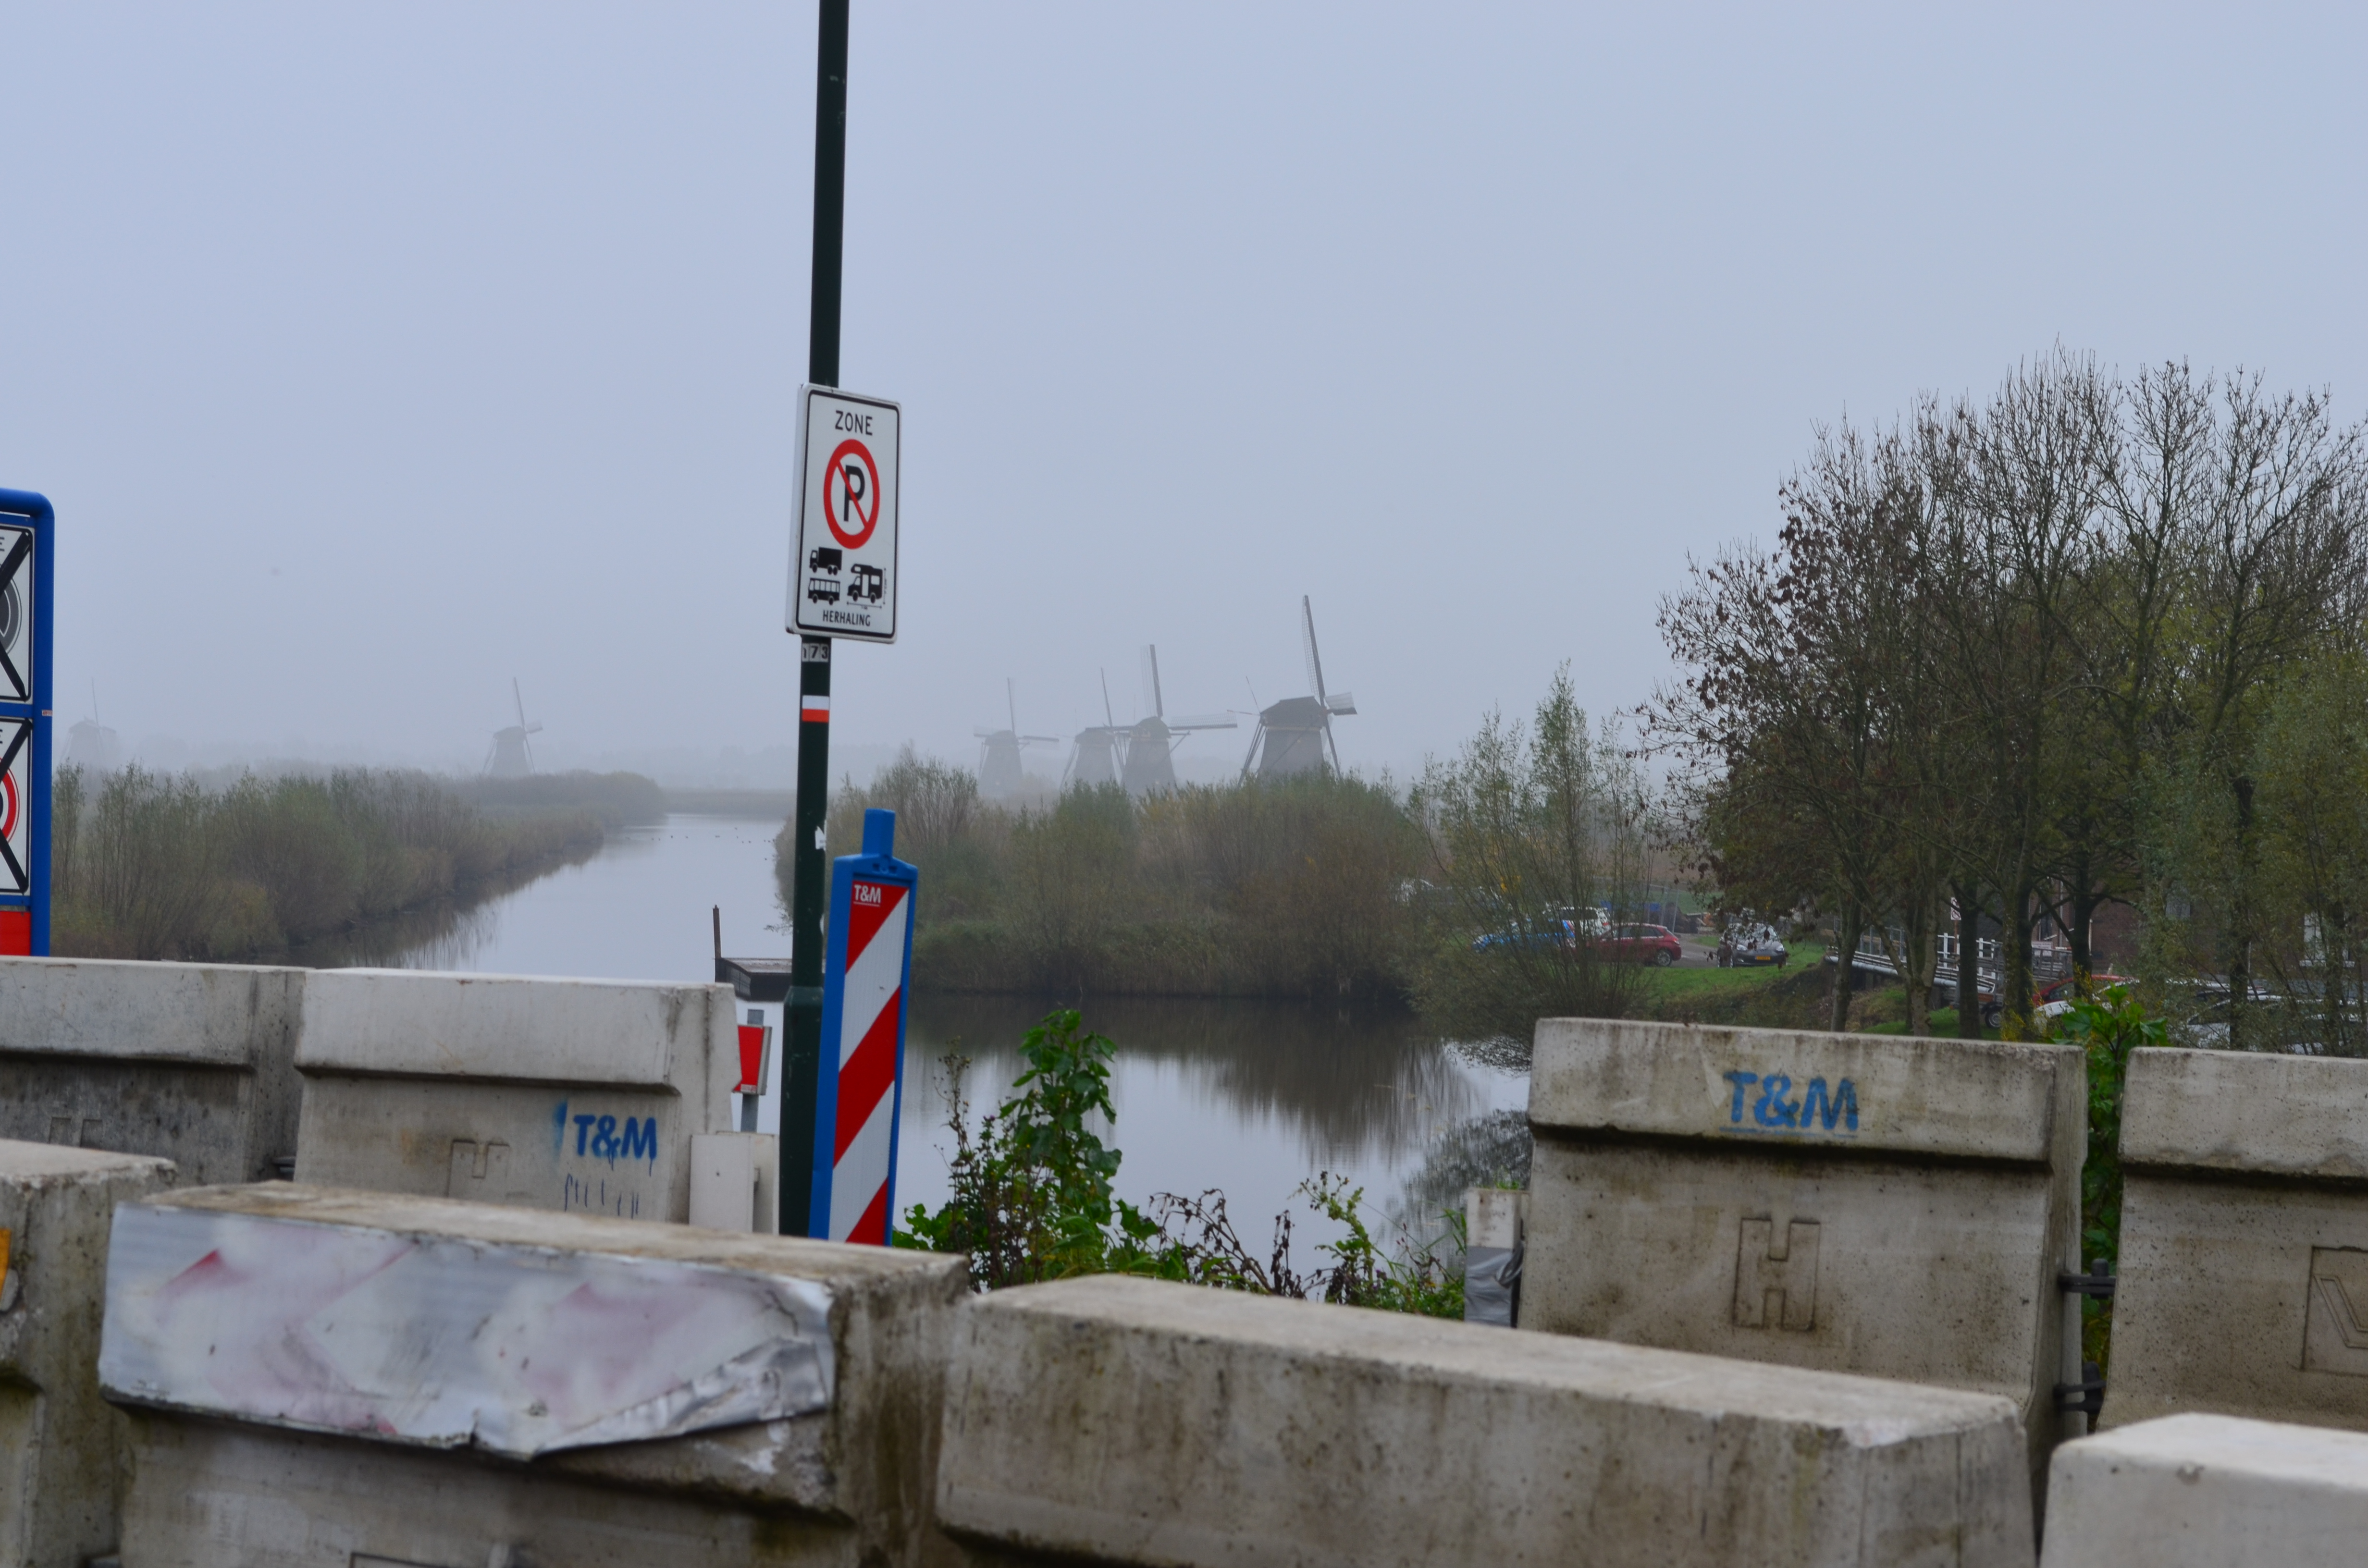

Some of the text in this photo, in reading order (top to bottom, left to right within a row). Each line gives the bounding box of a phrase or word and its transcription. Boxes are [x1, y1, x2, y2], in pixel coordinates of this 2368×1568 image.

[835, 410, 873, 436] ZONE
[844, 465, 865, 522] P
[823, 610, 871, 626] HERHALING
[803, 646, 828, 659] 173
[854, 884, 882, 904] T&M
[1723, 1071, 1859, 1131] T&M
[573, 1114, 657, 1161] T&M
